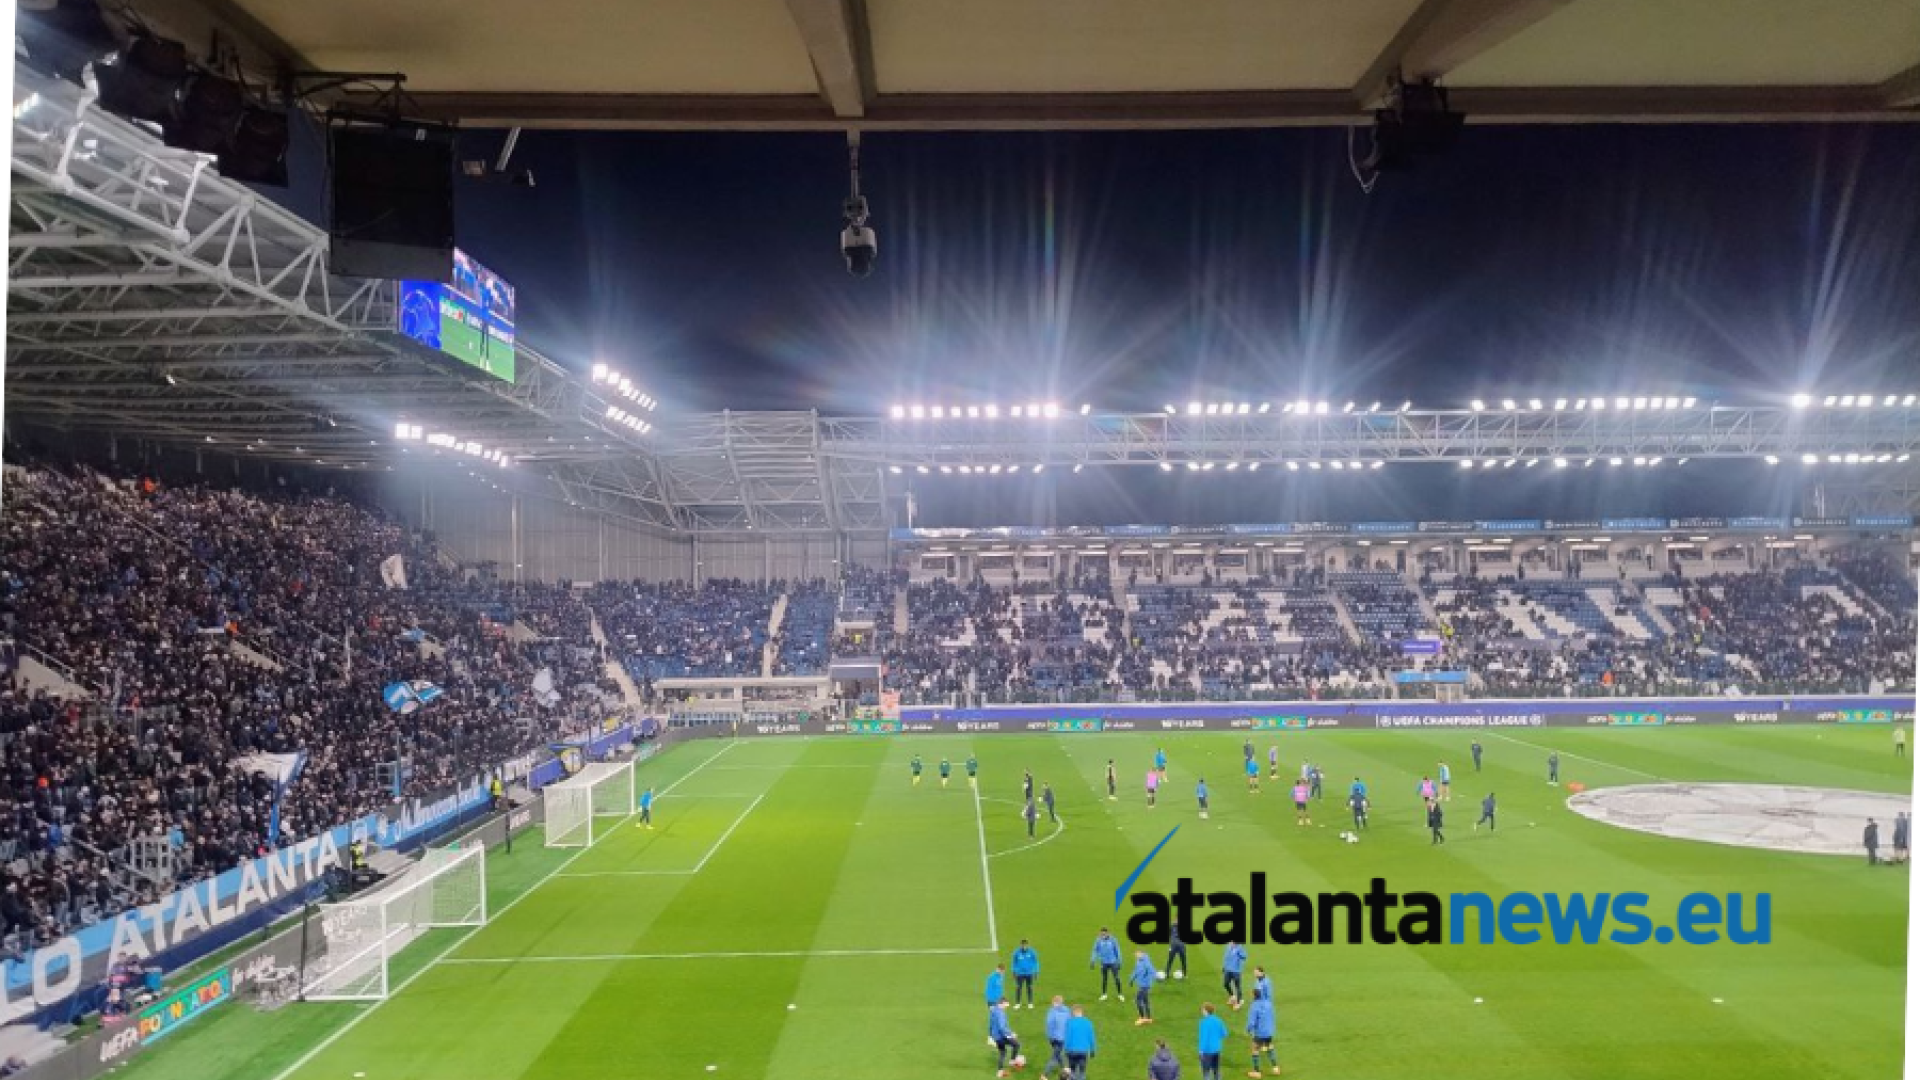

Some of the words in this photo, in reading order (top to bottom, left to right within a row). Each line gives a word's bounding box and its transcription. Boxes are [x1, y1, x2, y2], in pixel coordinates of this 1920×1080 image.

[1392, 715, 1420, 726] UEFA
[1422, 715, 1485, 726] CHAMPIONS
[1488, 715, 1528, 726] LEAGUE
[107, 830, 343, 974] ATALANTA
